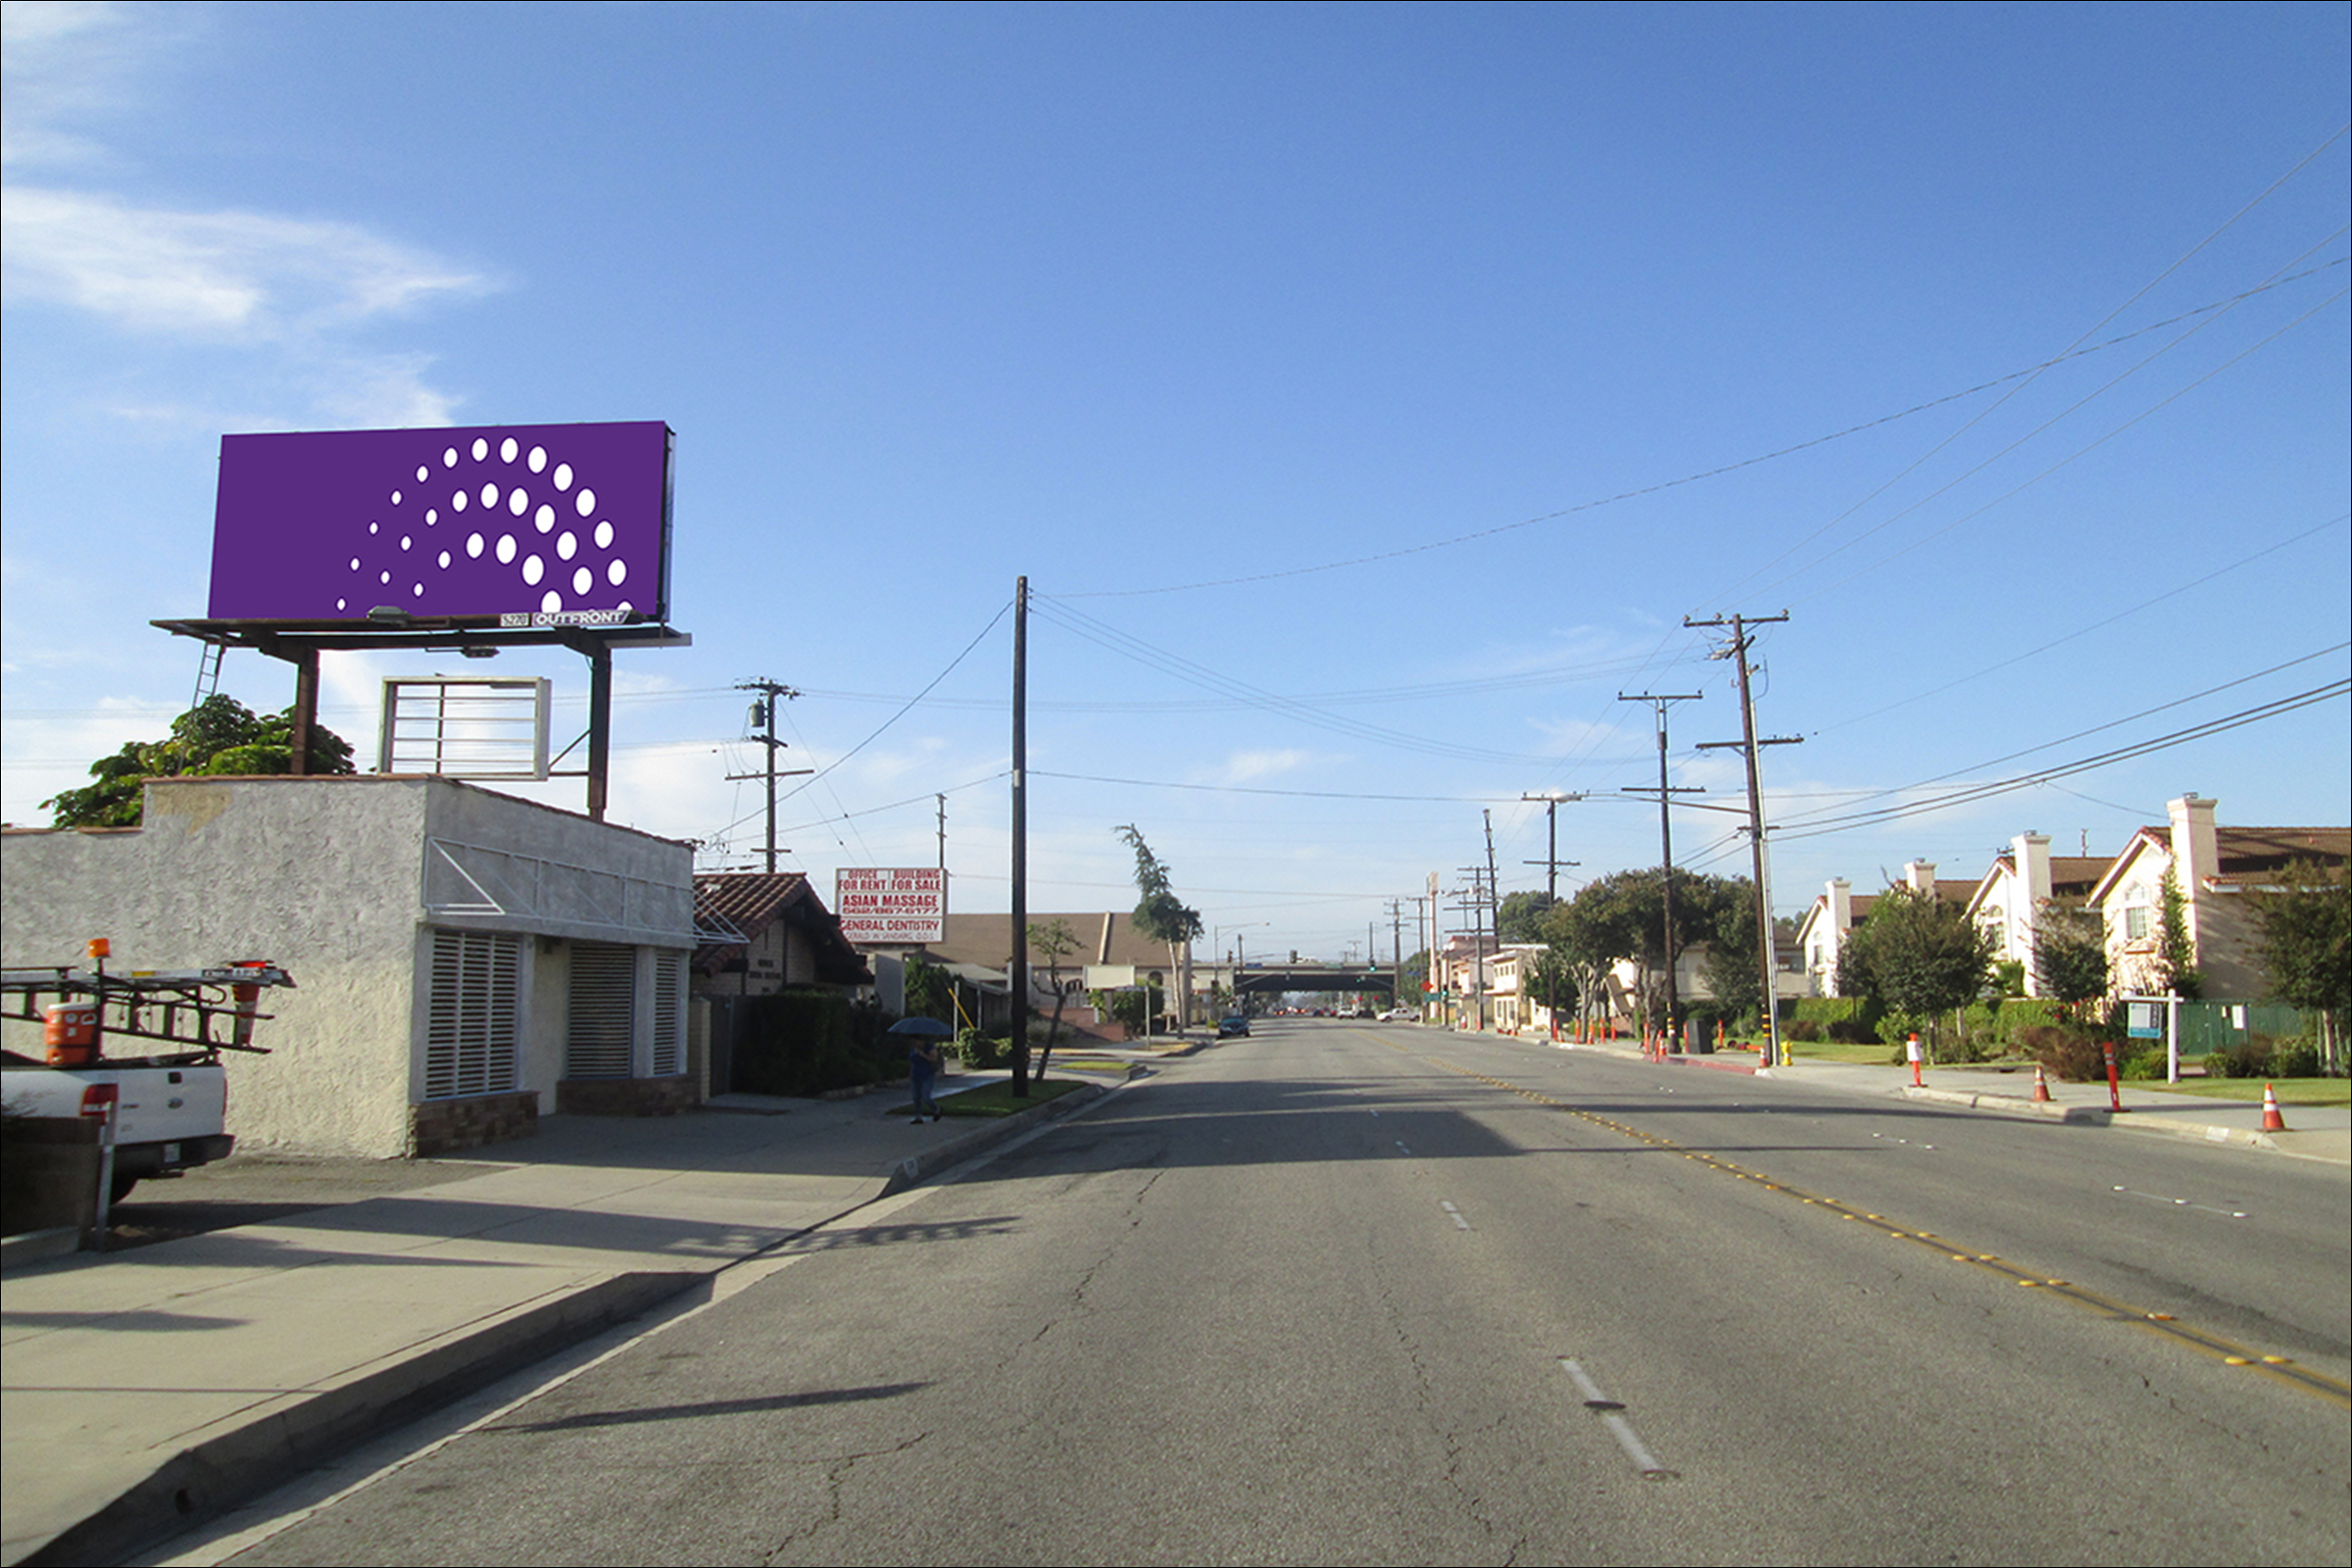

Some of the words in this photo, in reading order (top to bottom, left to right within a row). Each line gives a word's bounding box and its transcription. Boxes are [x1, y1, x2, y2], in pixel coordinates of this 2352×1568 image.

[536, 612, 622, 624] OUTFRONT
[848, 869, 877, 879] OFFICE
[894, 869, 941, 879] BUILDING
[838, 880, 858, 891] FOR
[860, 880, 887, 891] RENT
[891, 880, 912, 891] FOR
[915, 880, 941, 891] SALE
[843, 895, 878, 906] ASIAN
[882, 895, 938, 906] MASSAGE
[839, 919, 885, 931] GENERAL
[887, 919, 940, 931] DENTISTRY
